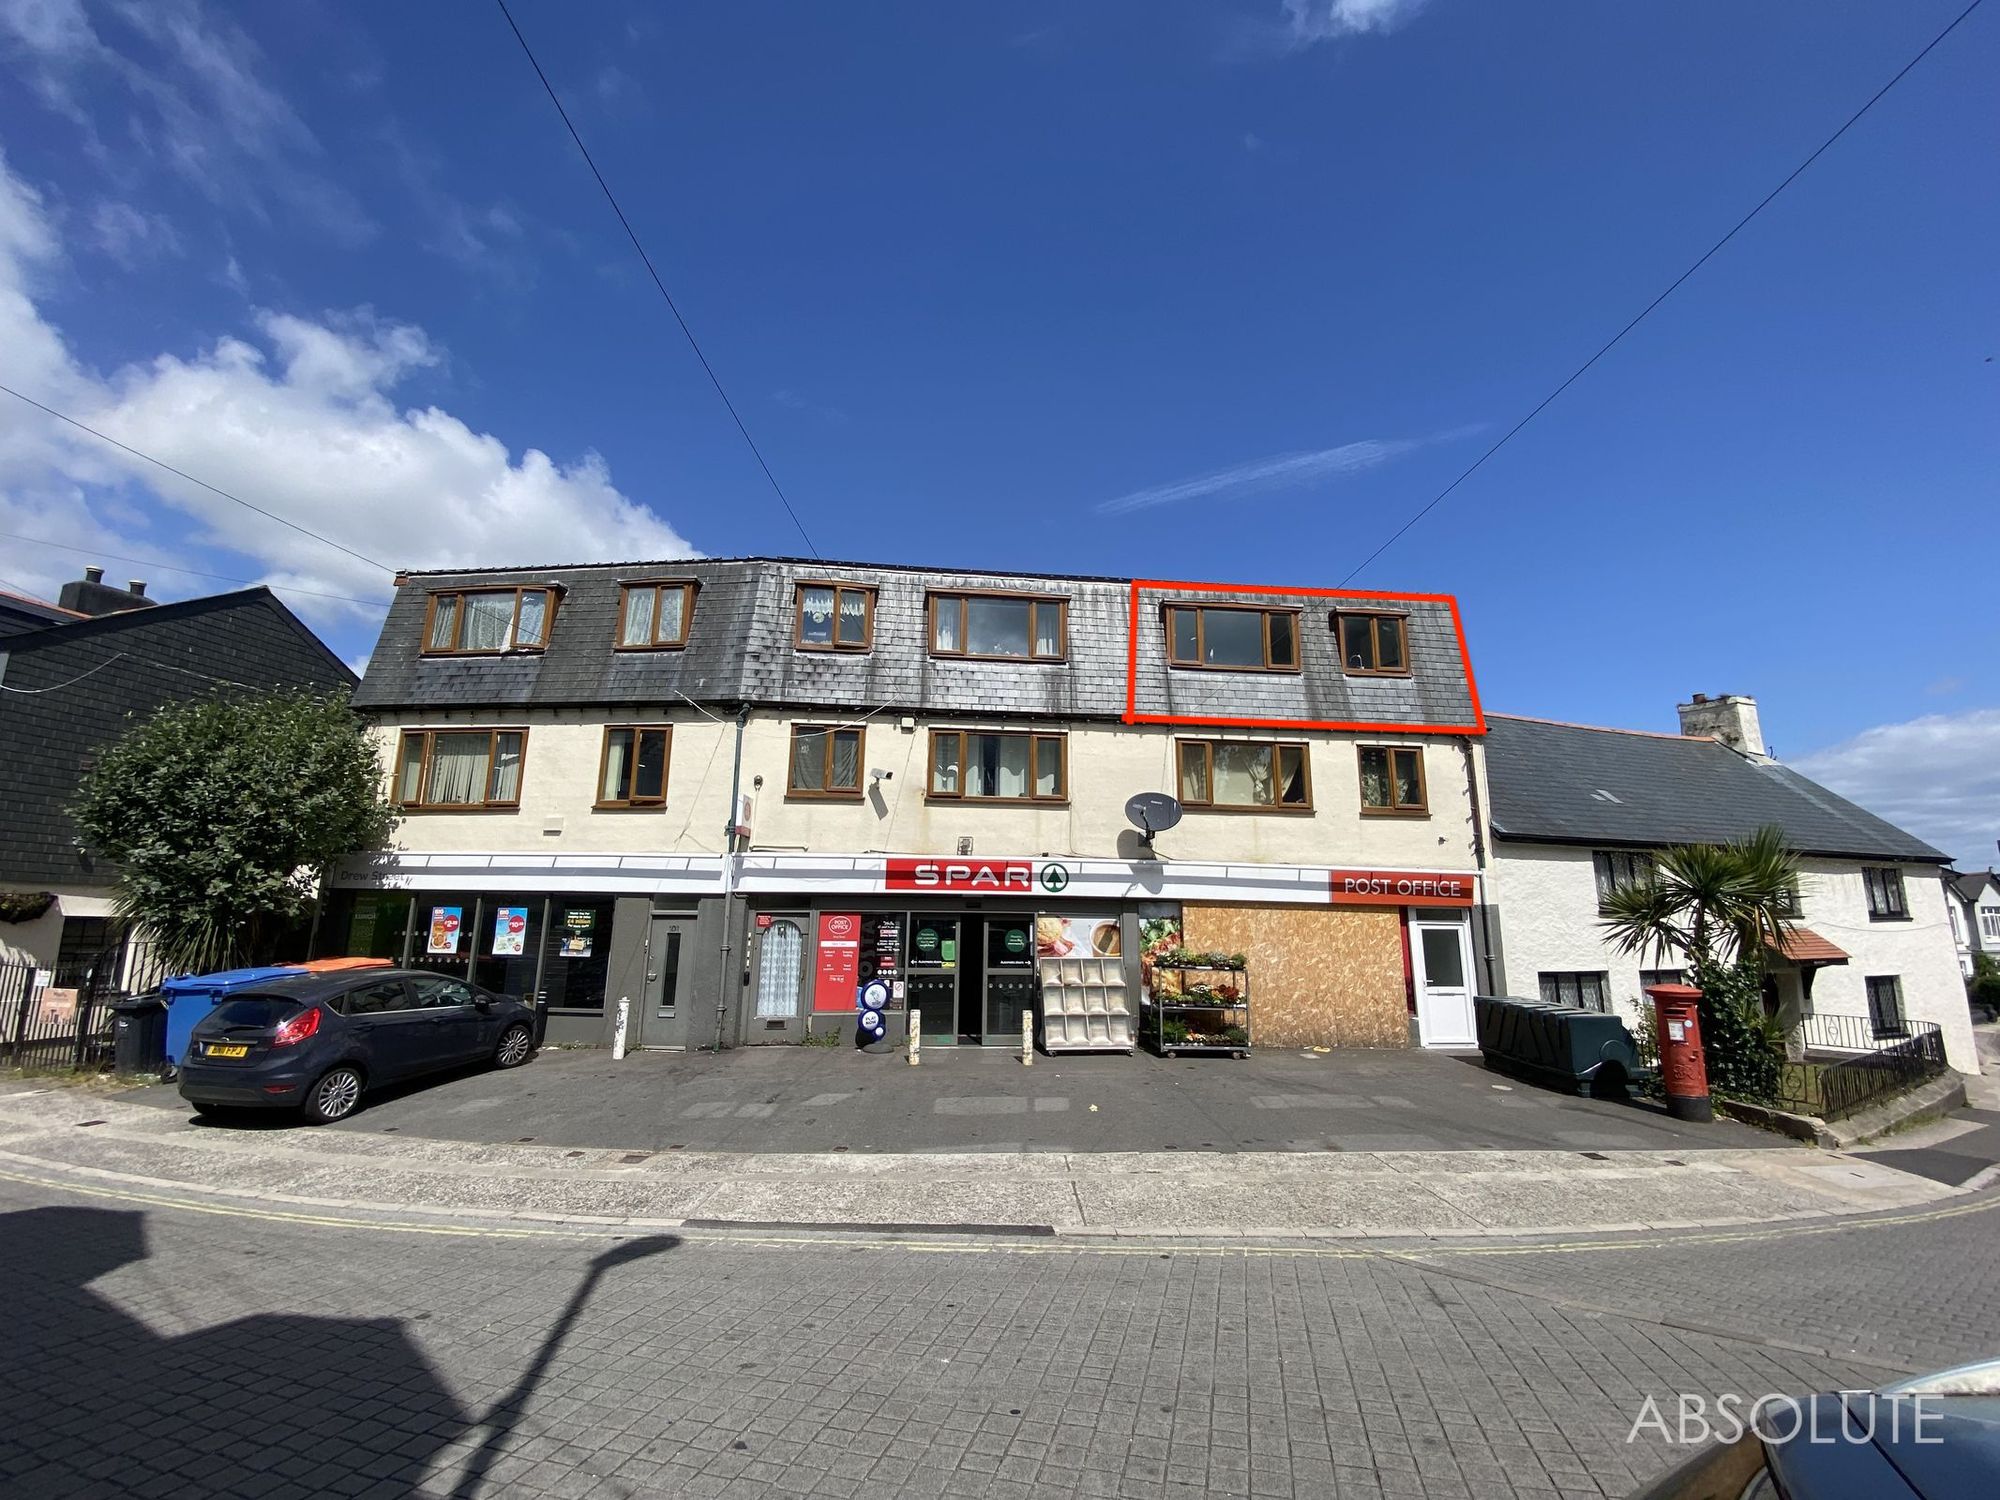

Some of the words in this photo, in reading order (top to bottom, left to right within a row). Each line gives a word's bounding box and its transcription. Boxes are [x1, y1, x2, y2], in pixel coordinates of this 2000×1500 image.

[341, 871, 369, 881] Drew
[914, 864, 1031, 887] SPAR
[1344, 878, 1391, 895] POST
[1397, 879, 1461, 897] OFFICE
